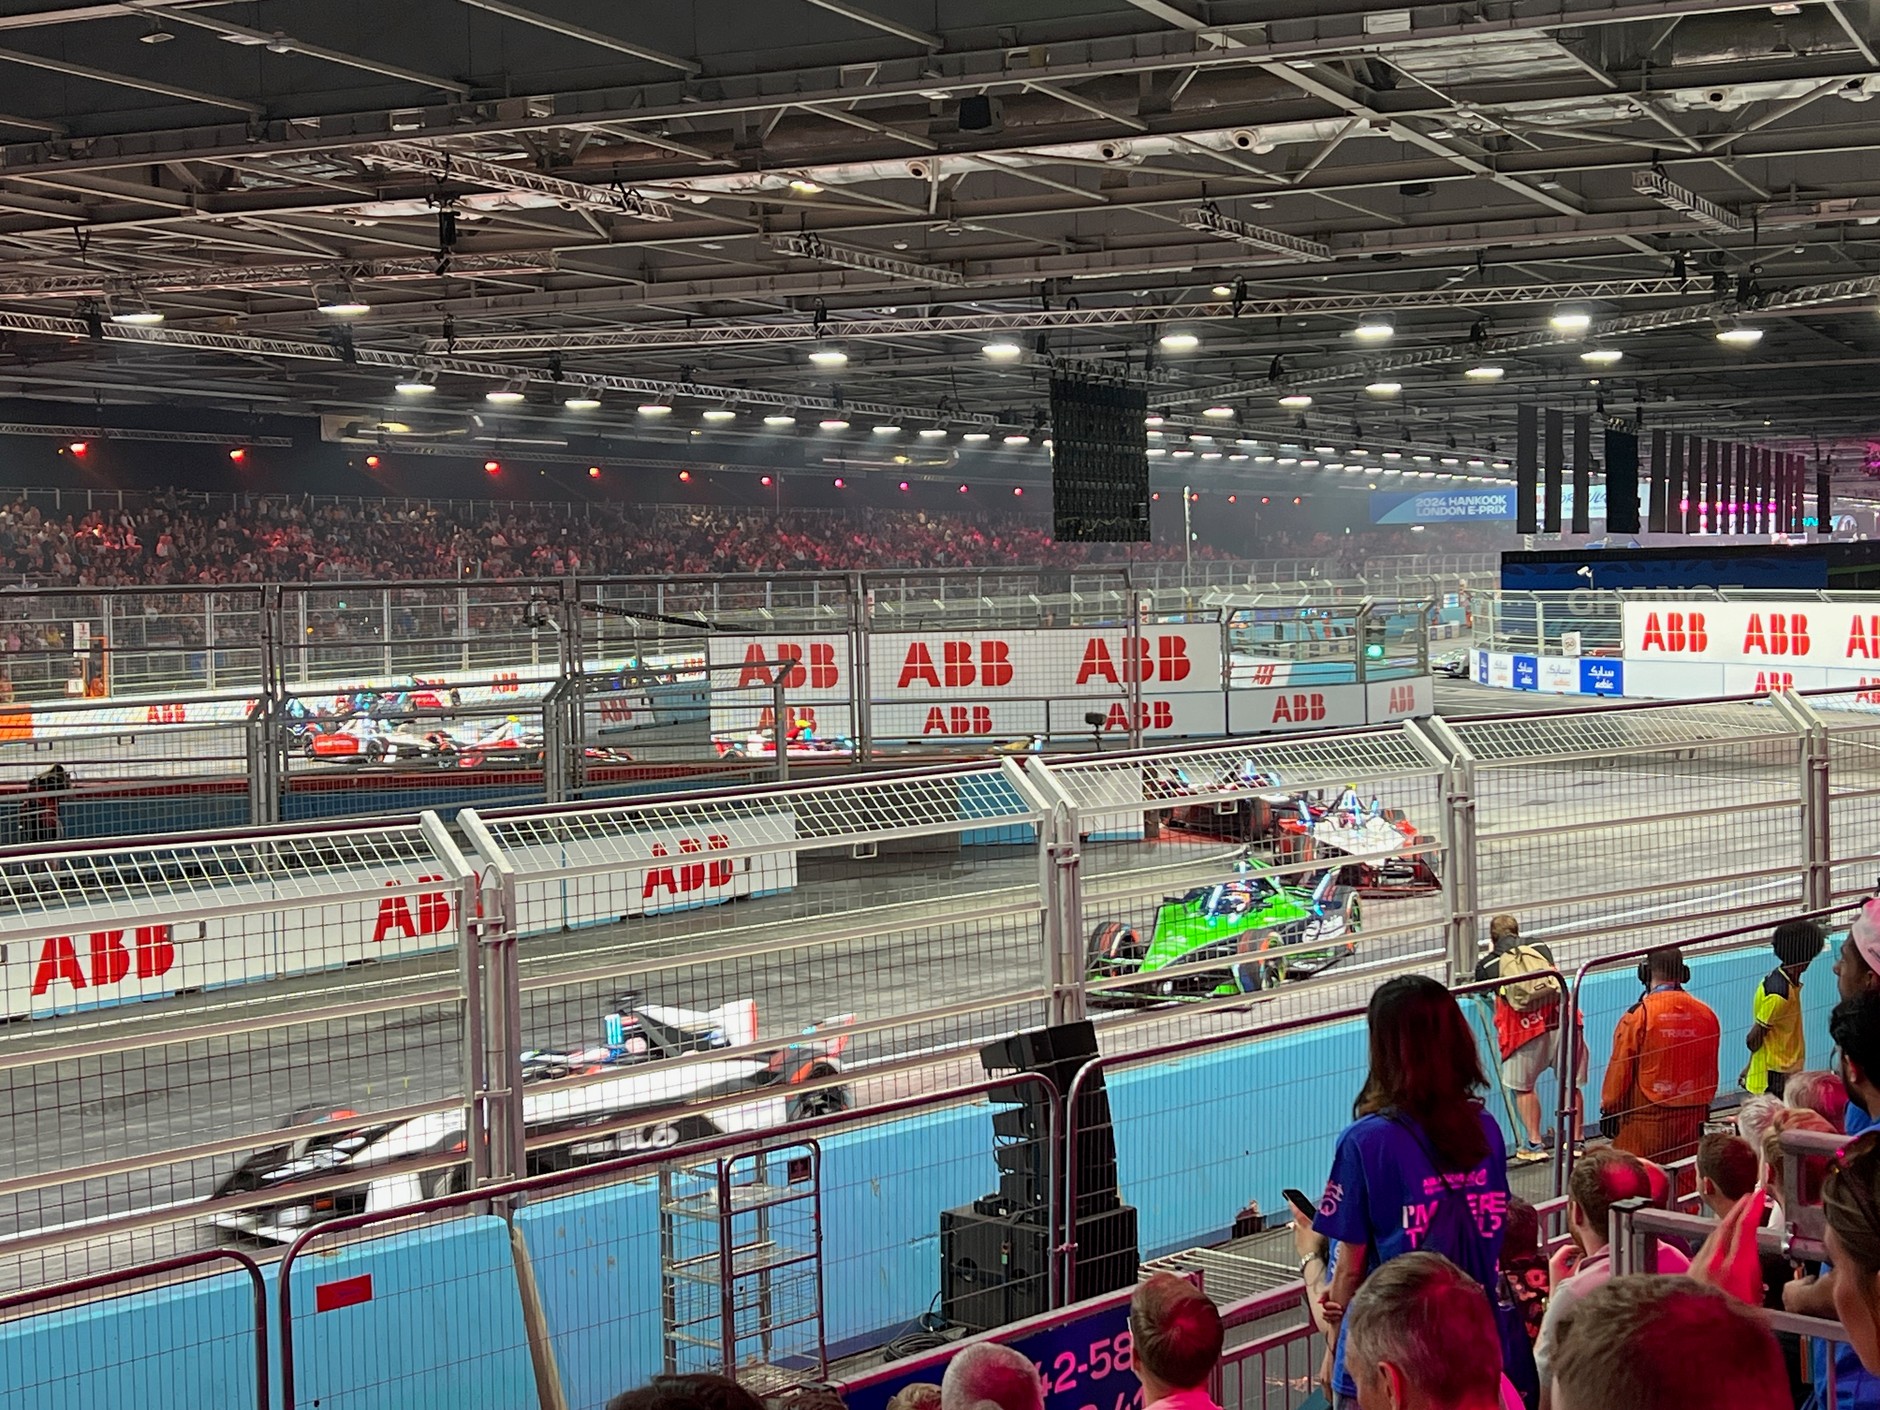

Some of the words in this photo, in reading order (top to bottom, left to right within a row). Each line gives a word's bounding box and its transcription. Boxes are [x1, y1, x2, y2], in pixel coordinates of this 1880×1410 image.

[1416, 497, 1447, 507] 2024
[1448, 495, 1507, 506] HANKOOK
[1416, 506, 1465, 517] LONDON
[1467, 505, 1507, 515] E-PRIX
[1642, 612, 1708, 652] ABB
[1743, 613, 1810, 656] ABB
[738, 643, 839, 688] ABB
[897, 640, 1013, 688] ABB
[1076, 635, 1191, 684] ABB
[1389, 685, 1415, 714] ABB
[1755, 671, 1793, 693] ABB
[923, 706, 993, 734] ABB
[1104, 701, 1174, 731] ABB
[1272, 693, 1326, 723] ABB
[643, 834, 733, 899] ABB
[31, 923, 174, 996] ABB
